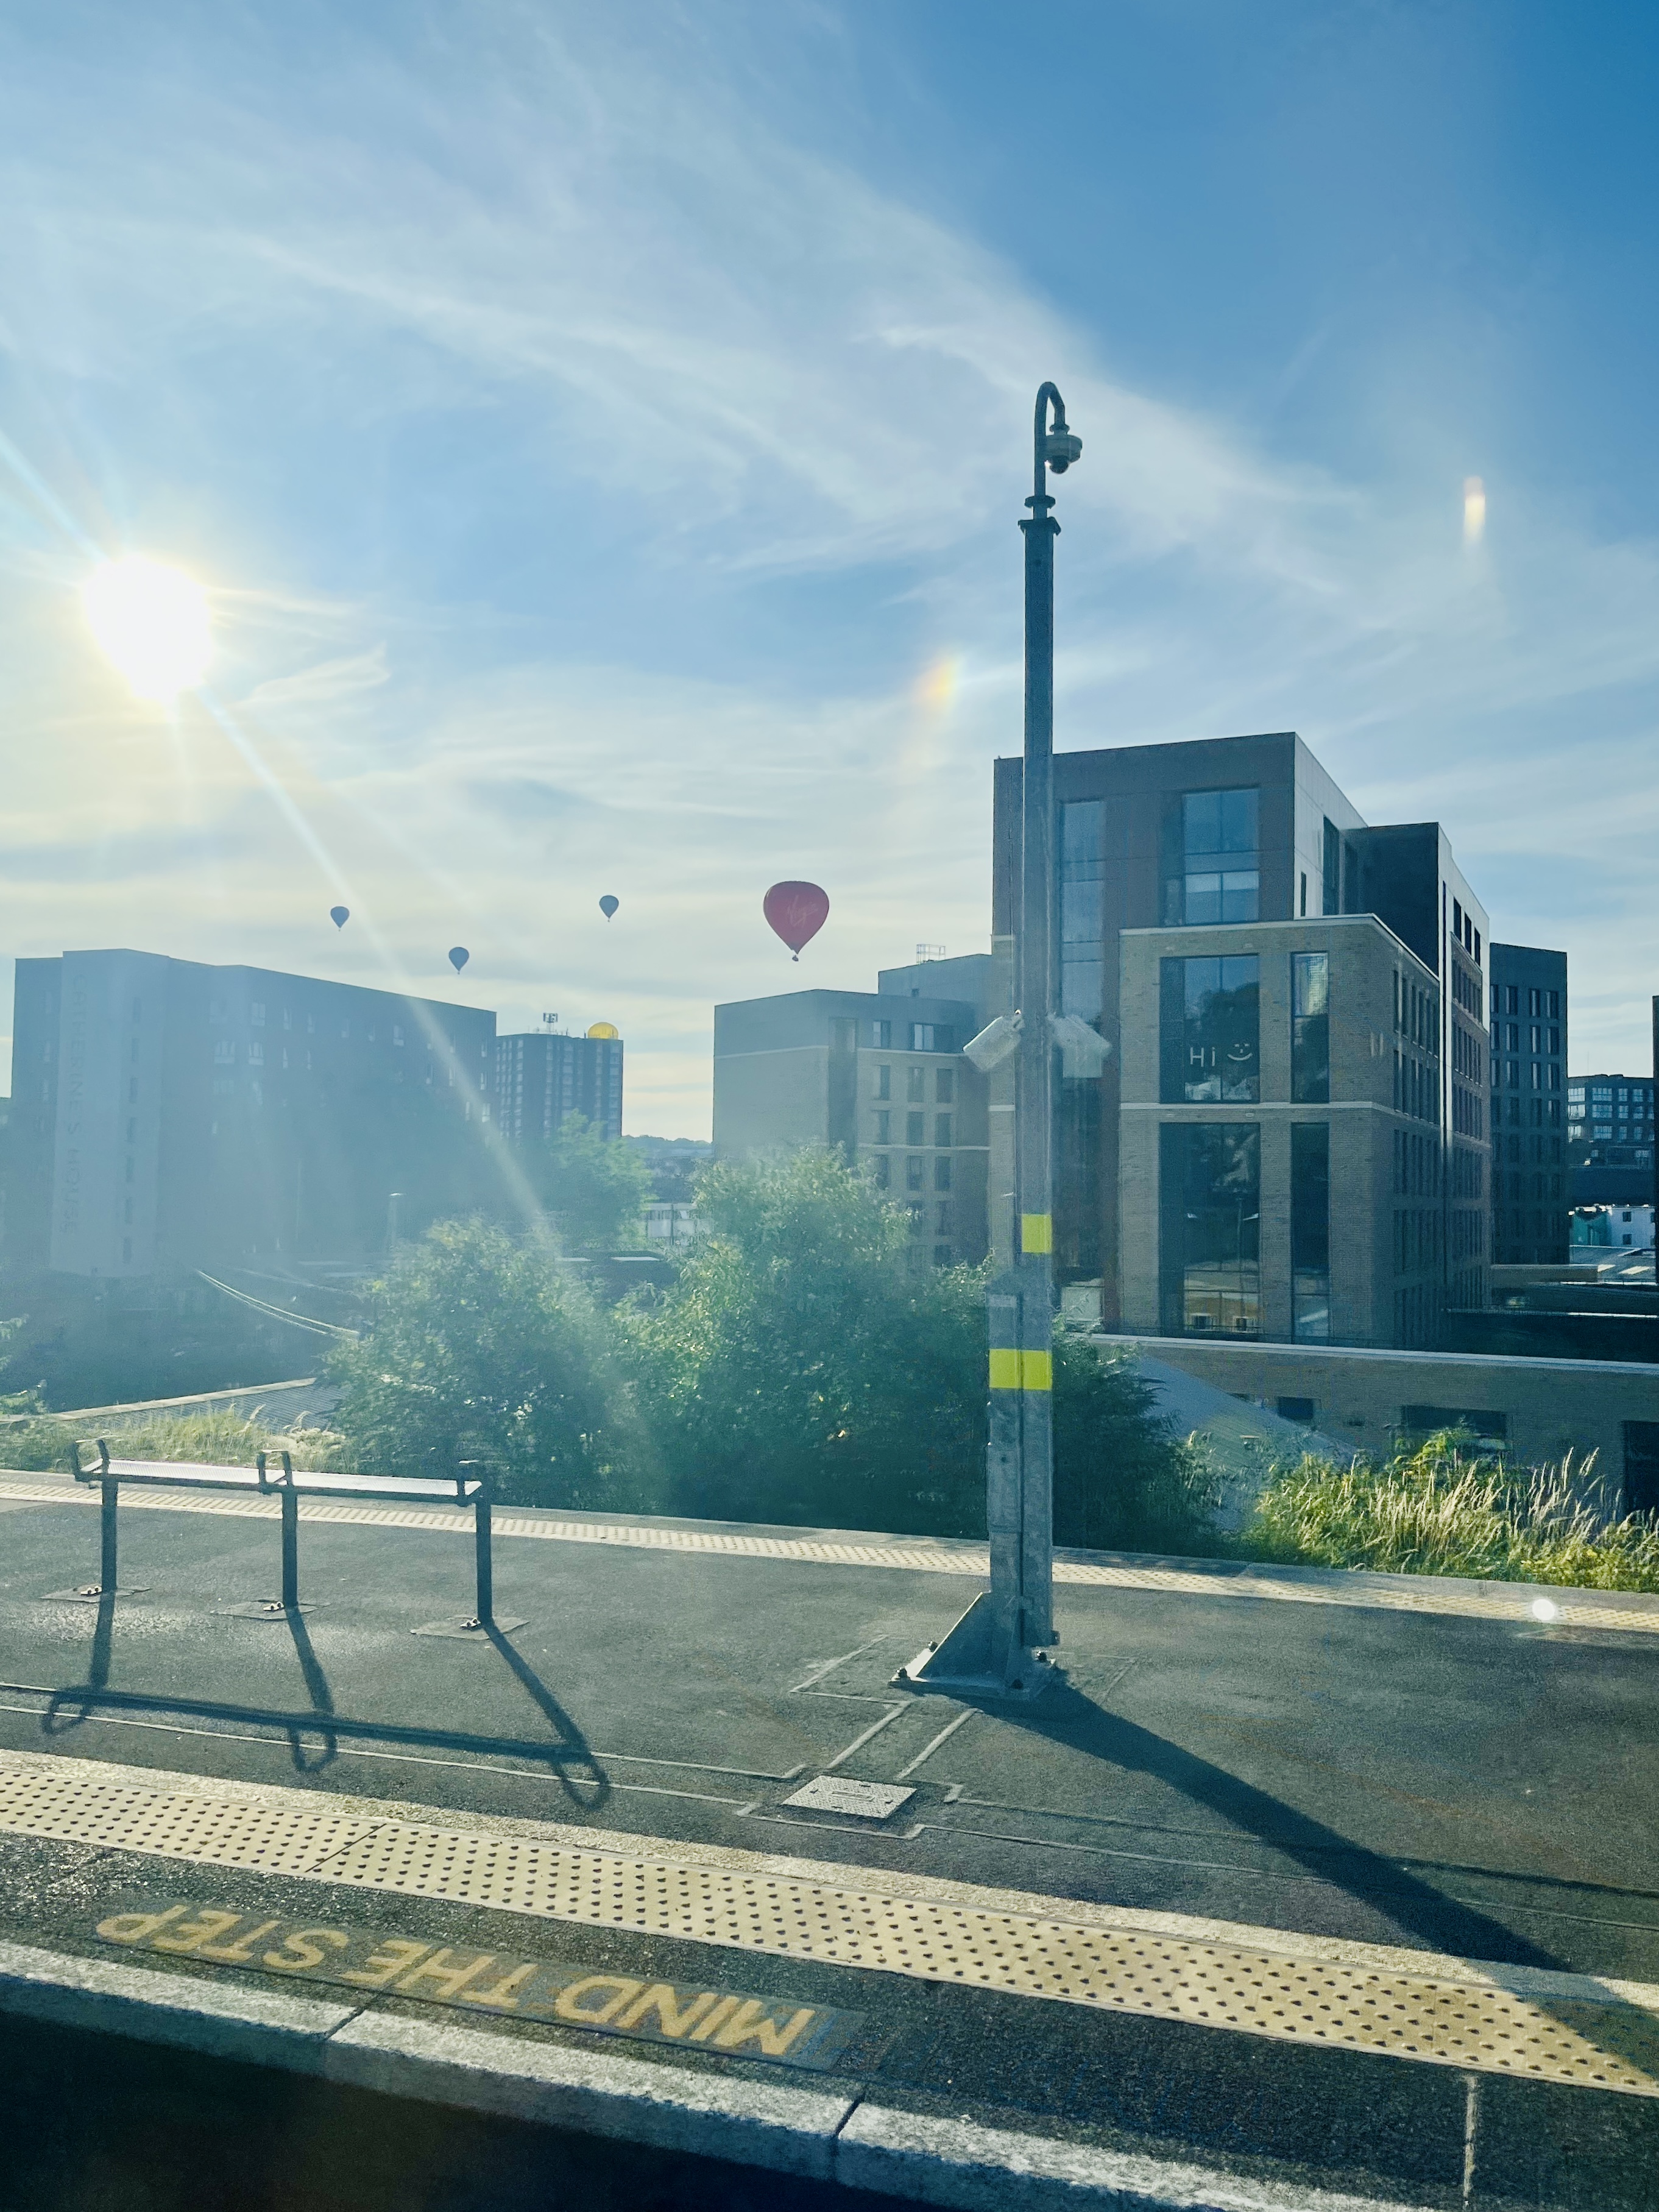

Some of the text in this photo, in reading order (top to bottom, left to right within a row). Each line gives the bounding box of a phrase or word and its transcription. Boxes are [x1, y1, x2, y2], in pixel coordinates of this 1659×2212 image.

[1190, 1046, 1215, 1067] Hi
[59, 1148, 81, 1234] HOUSE
[96, 1904, 816, 2055] MIND THE STEP
